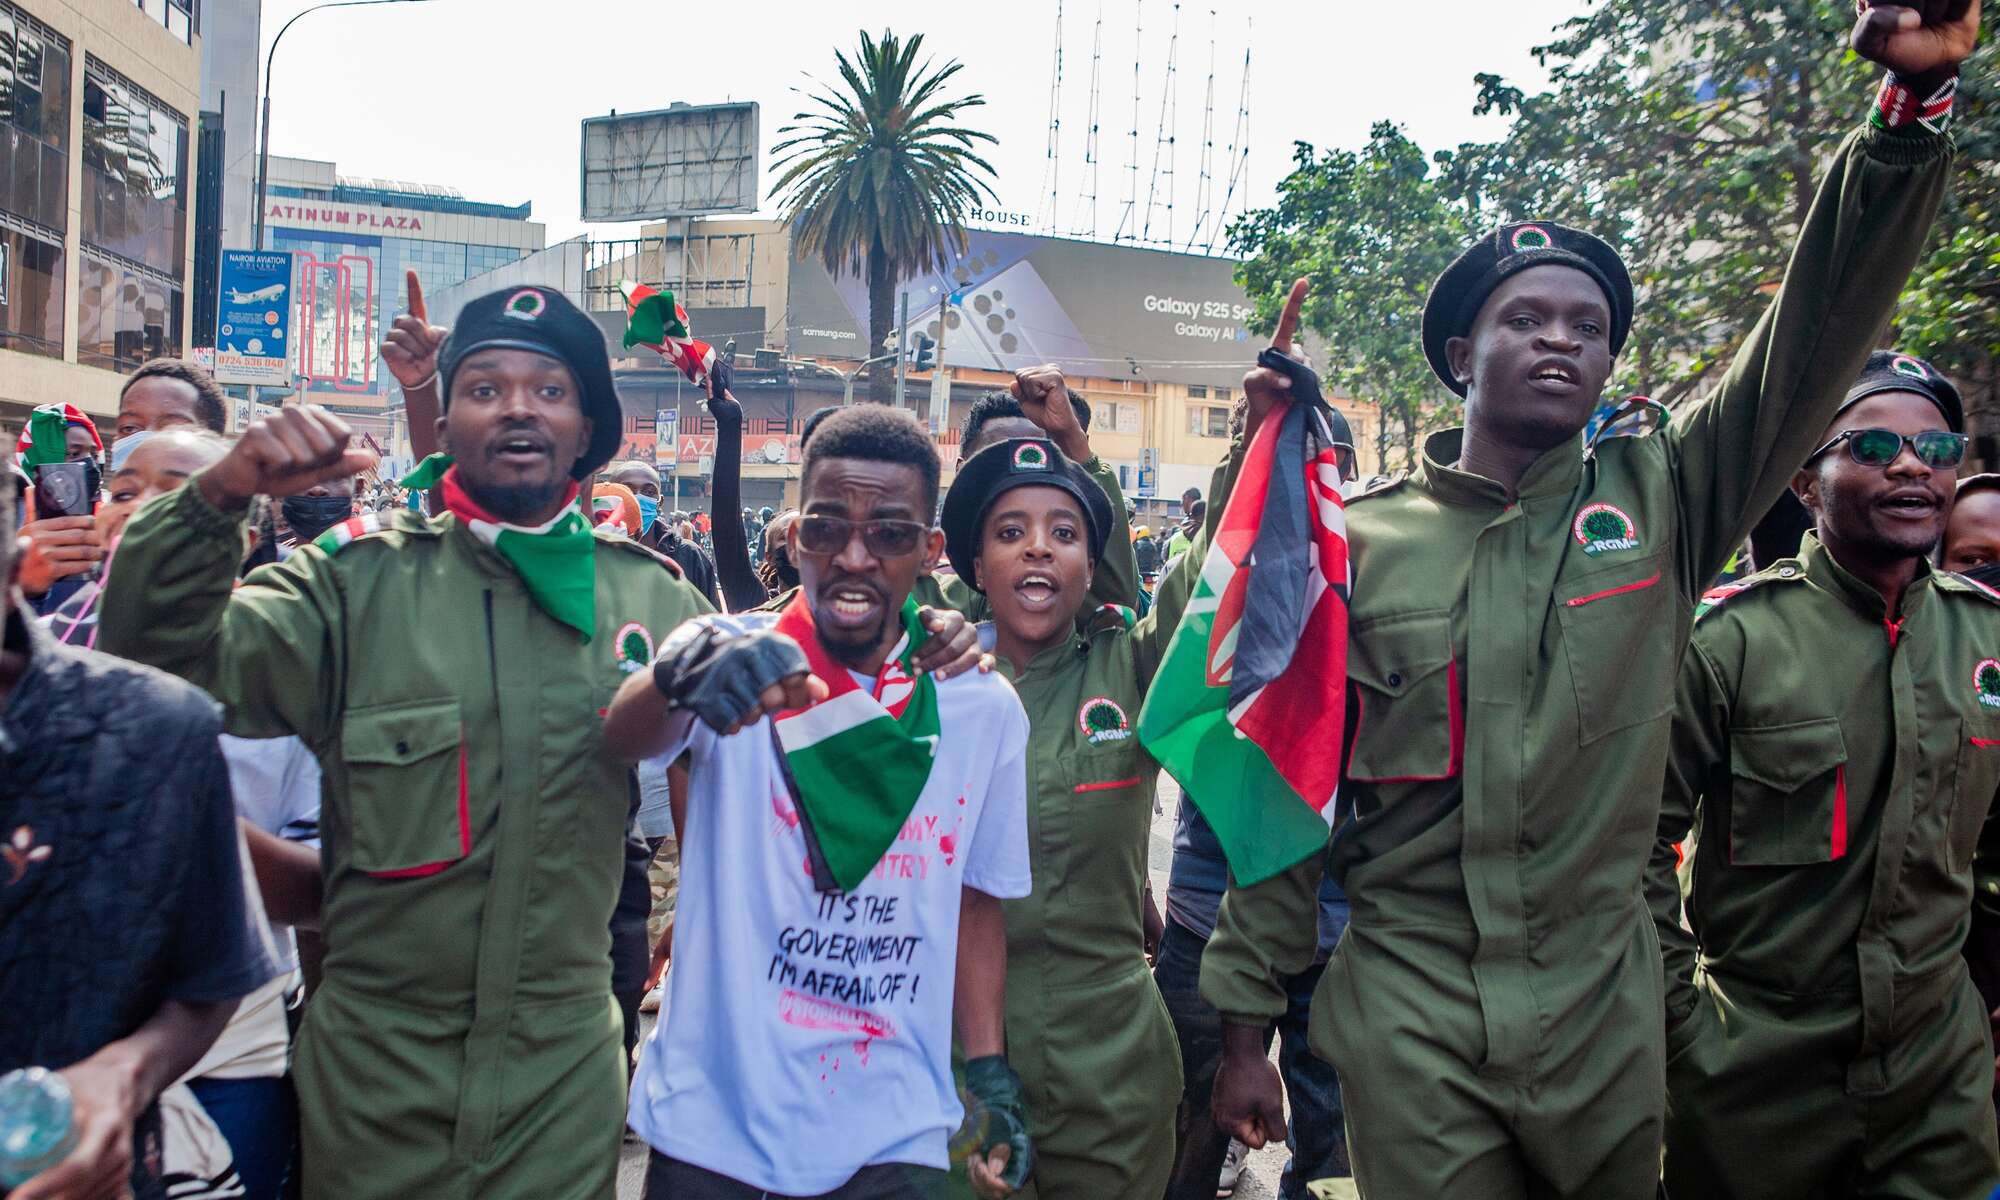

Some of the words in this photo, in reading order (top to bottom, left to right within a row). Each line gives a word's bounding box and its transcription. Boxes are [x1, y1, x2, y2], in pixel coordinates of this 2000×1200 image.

[263, 205, 349, 224] ATINUM
[356, 212, 422, 230] PLAZA
[971, 207, 1030, 226] HOUSE
[229, 254, 255, 263] NAIROBI
[256, 256, 286, 265] AVIATION
[1144, 295, 1200, 320] Galaxy
[1203, 301, 1229, 319] S25
[803, 328, 856, 340] samsung.com
[1175, 322, 1220, 342] Galaxy
[1222, 327, 1234, 340] AI
[1593, 538, 1631, 552] RGM
[1095, 729, 1126, 741] RGM
[818, 892, 857, 923] IT'S
[862, 895, 898, 925] THE
[768, 953, 797, 985] I'M
[879, 973, 906, 1003] OF
